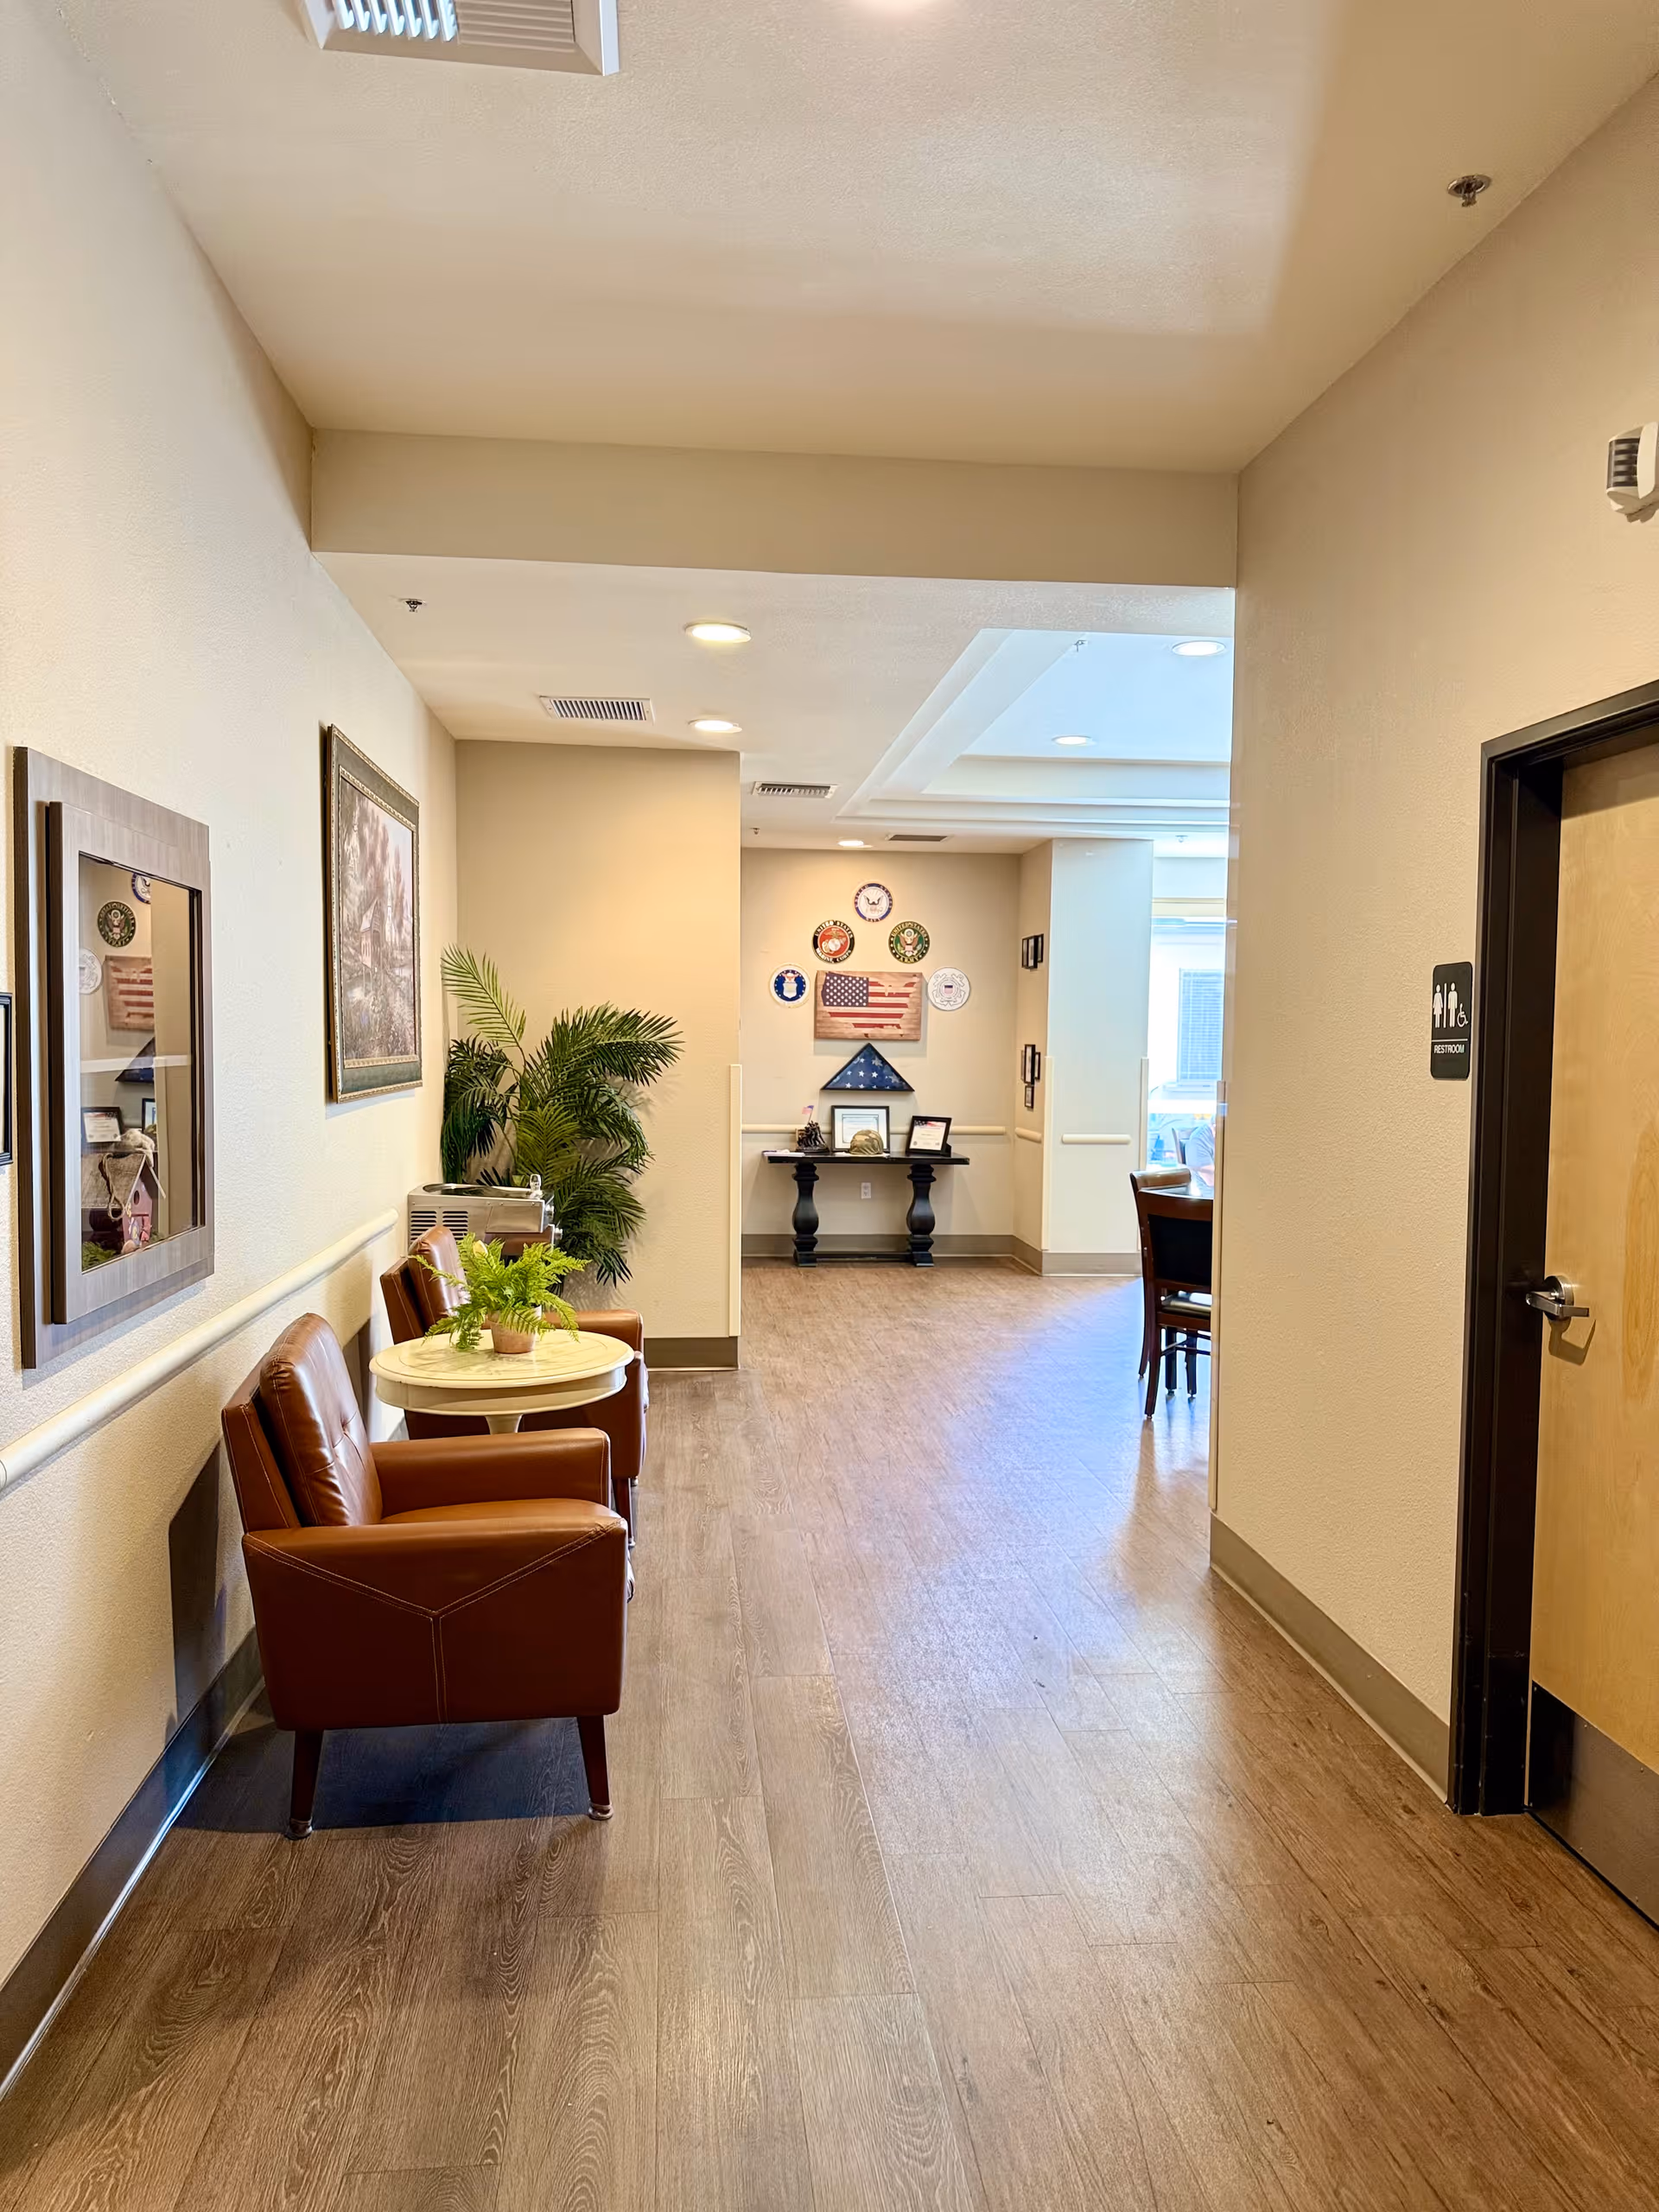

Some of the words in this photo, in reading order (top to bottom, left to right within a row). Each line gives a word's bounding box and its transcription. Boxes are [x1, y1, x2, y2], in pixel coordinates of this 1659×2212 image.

[815, 920, 834, 936] UNITED
[836, 921, 854, 938] STATES
[1433, 1044, 1465, 1054] RESTROOM
